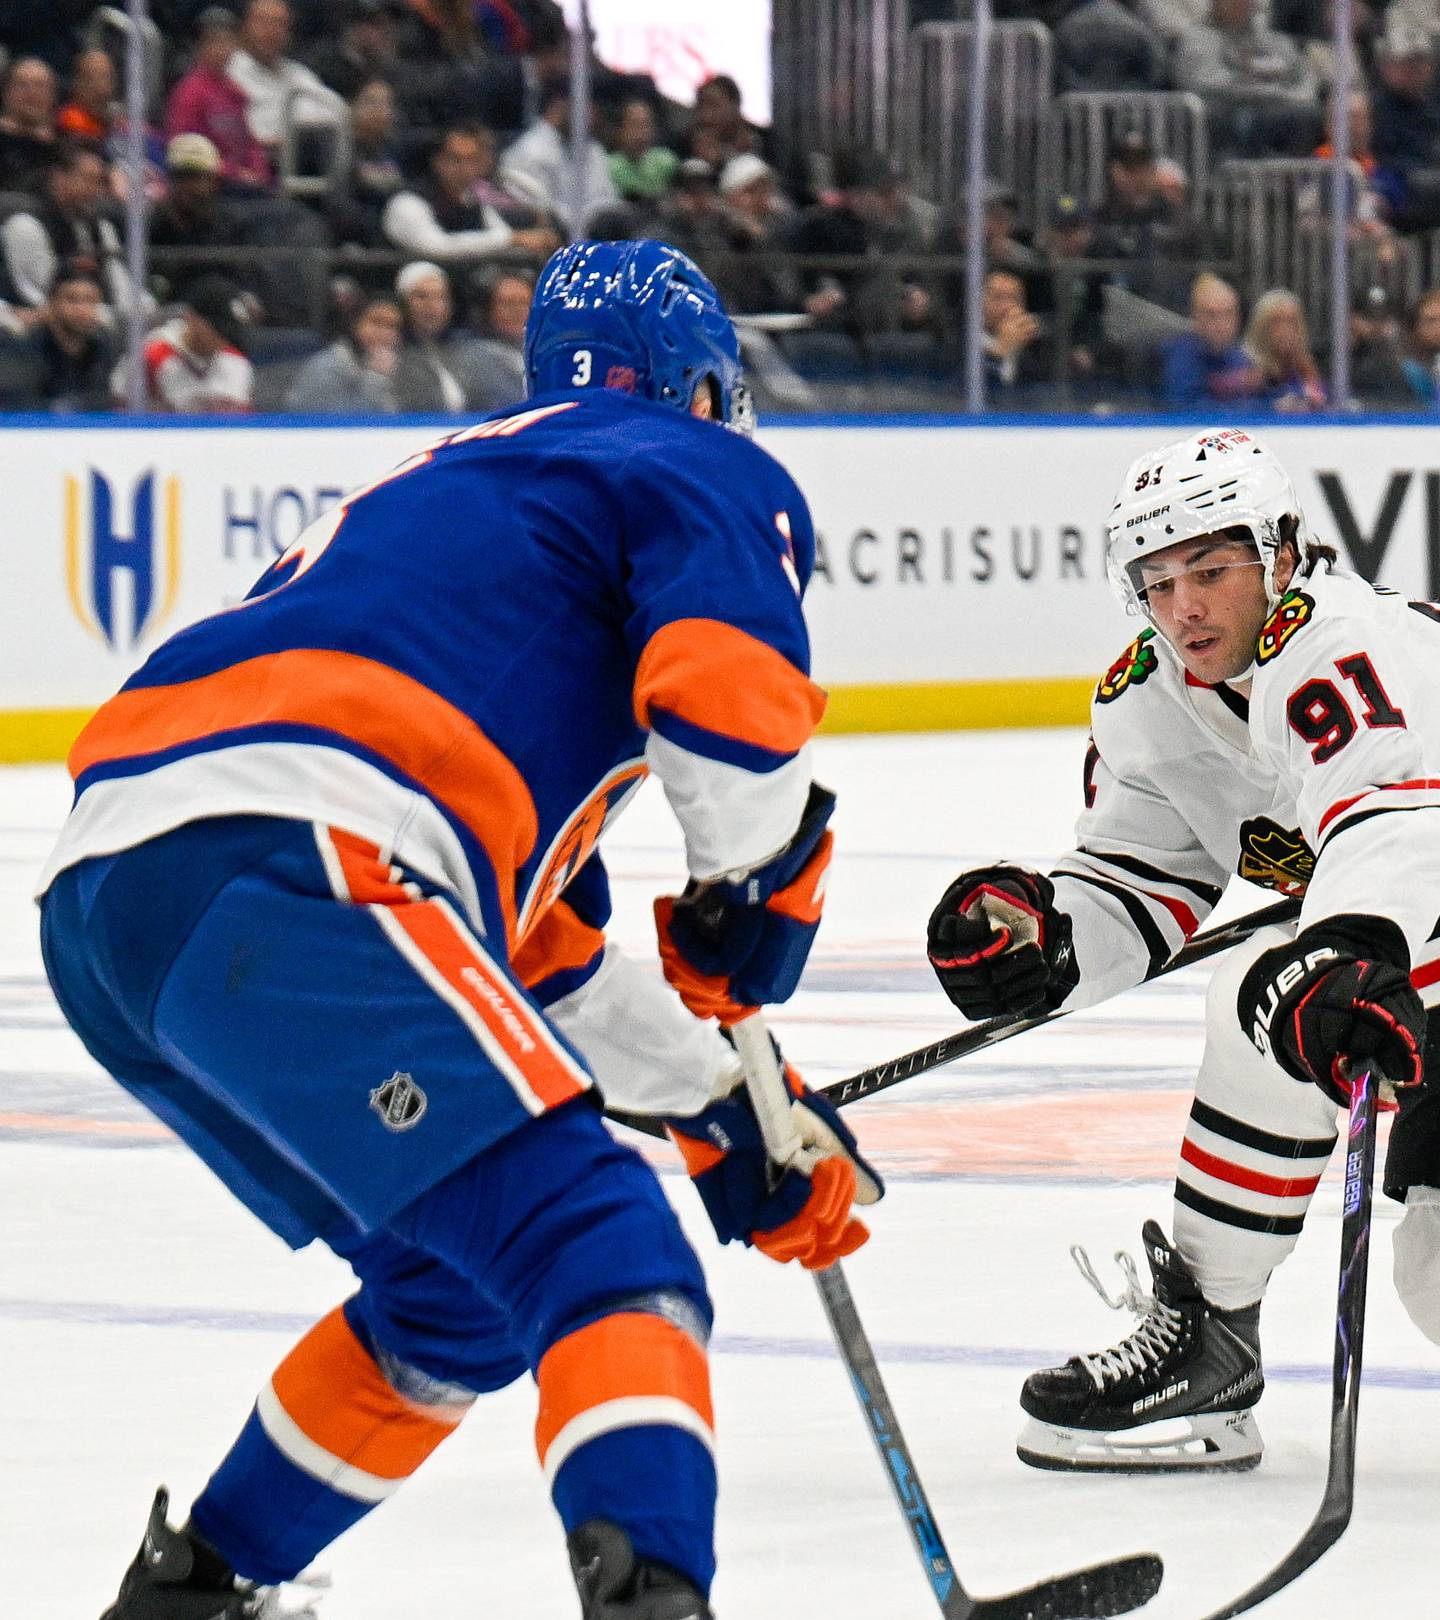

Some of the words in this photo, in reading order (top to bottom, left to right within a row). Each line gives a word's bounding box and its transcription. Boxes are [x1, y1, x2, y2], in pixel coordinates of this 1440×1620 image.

[572, 350, 592, 387] 3
[1134, 465, 1164, 492] 91
[1126, 505, 1170, 528] BAUER
[814, 525, 1108, 586] ACRISUR
[1286, 651, 1407, 766] 91
[461, 966, 537, 1053] BAUER
[841, 1040, 947, 1100] FLYLITE
[1345, 1149, 1364, 1207] BAUER
[1132, 1380, 1189, 1415] BAUER
